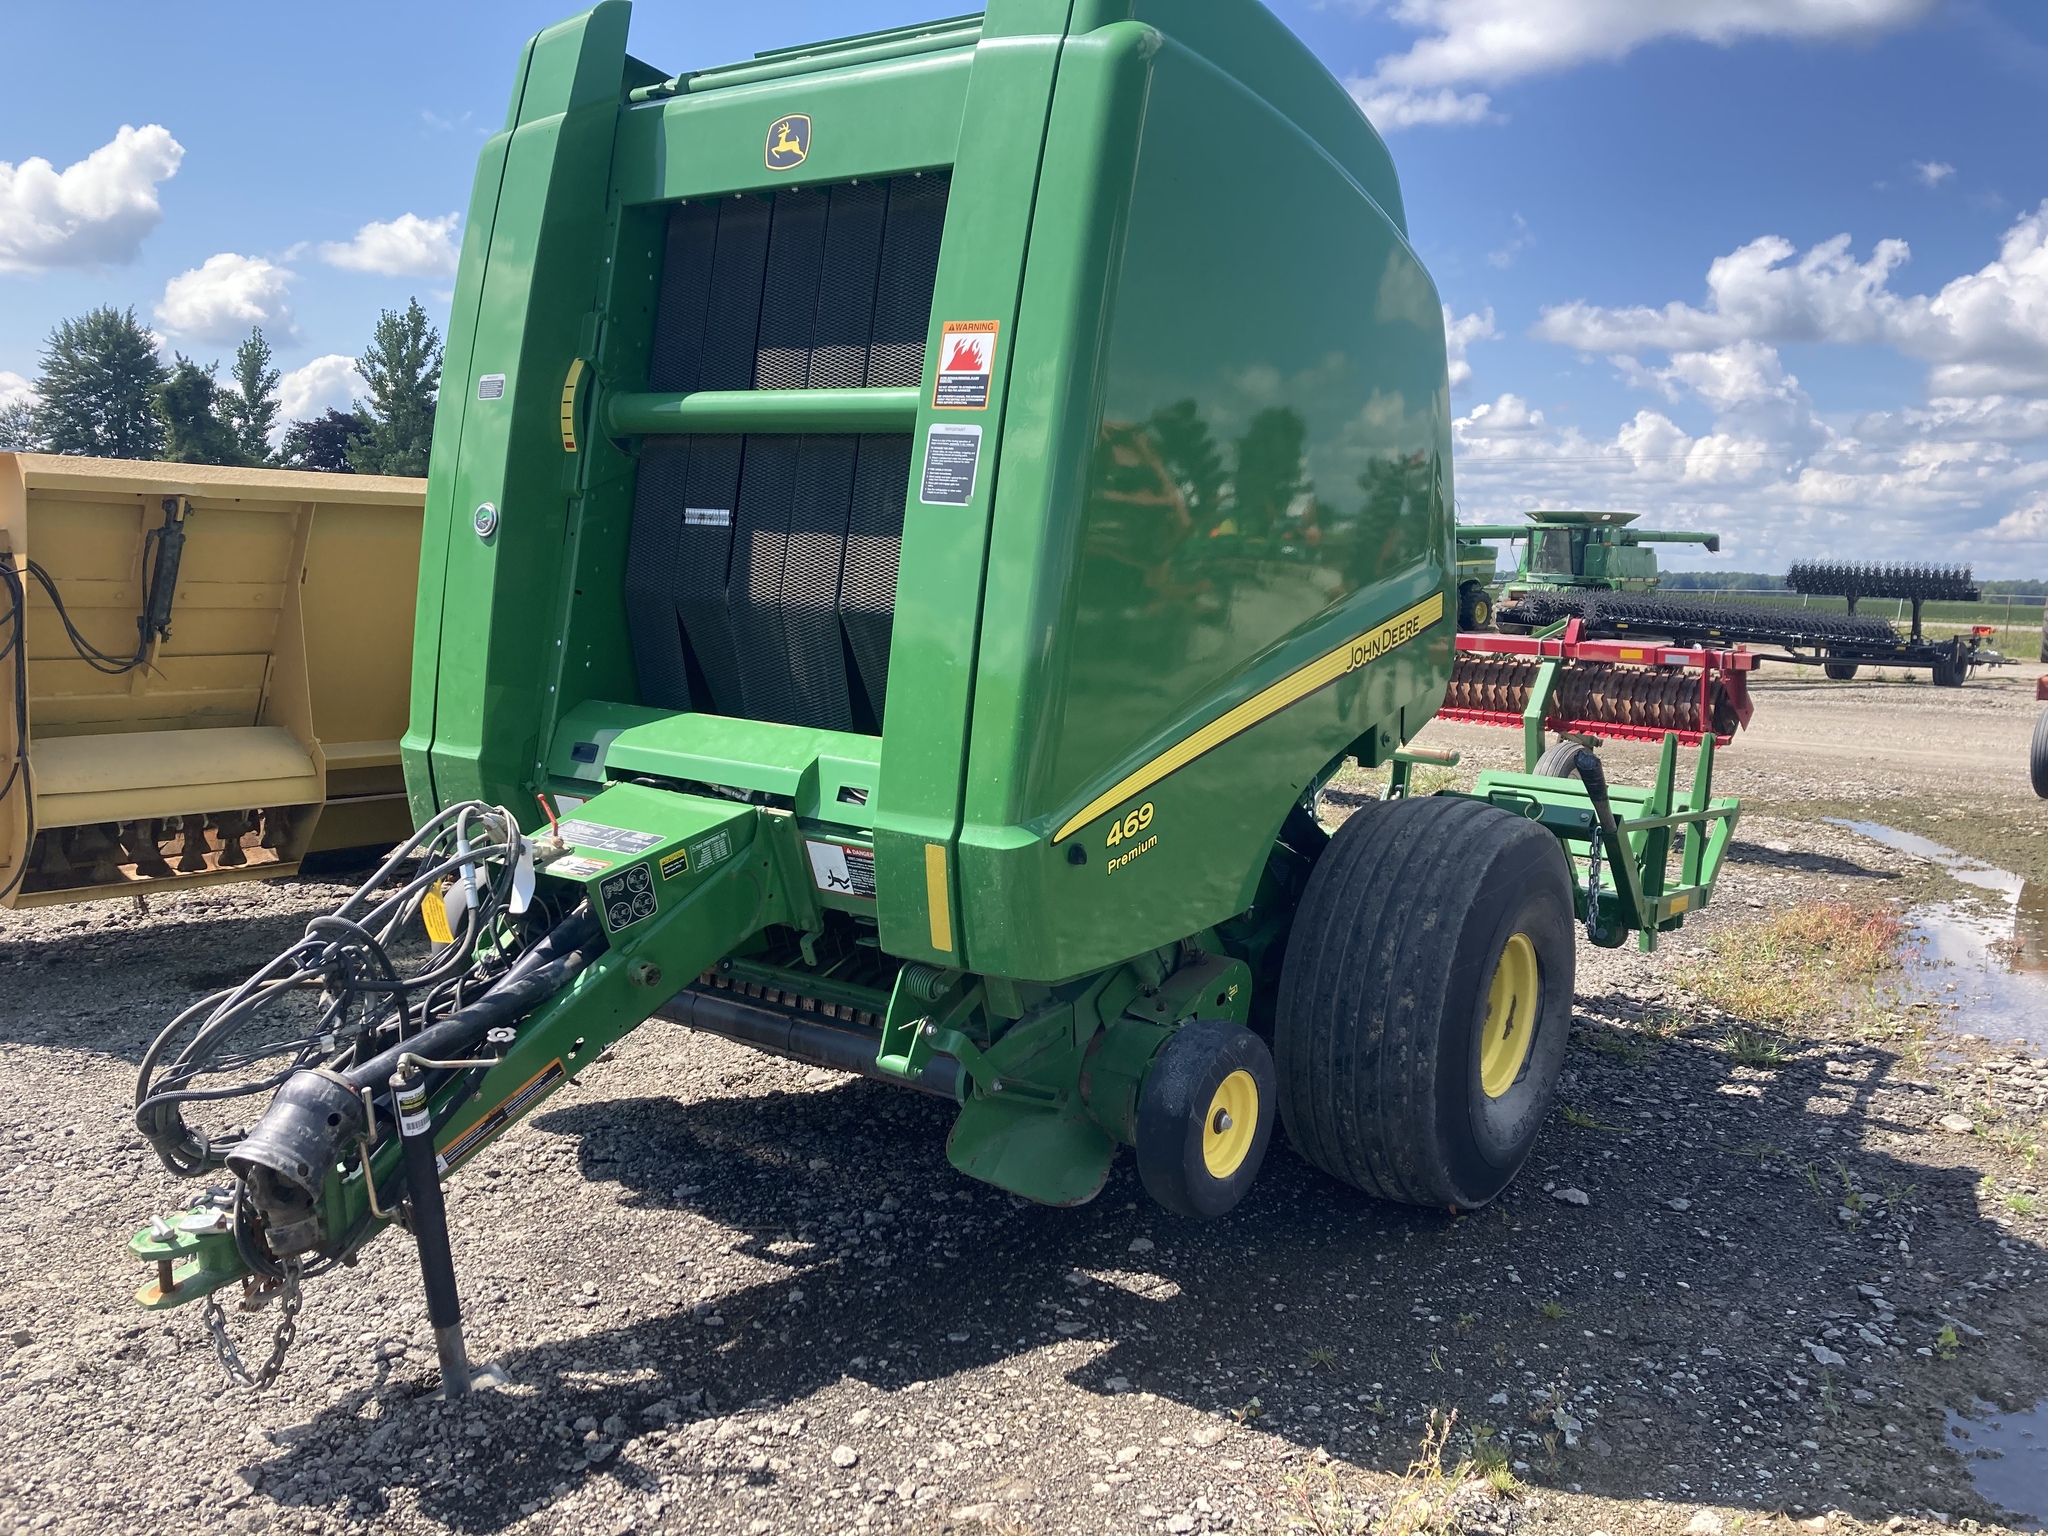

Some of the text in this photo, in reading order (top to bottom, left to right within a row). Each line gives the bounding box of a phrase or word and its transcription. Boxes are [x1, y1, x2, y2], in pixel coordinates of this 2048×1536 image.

[955, 322, 994, 331] WARNING
[1106, 801, 1155, 849] 469
[852, 849, 874, 858] DANGER
[1107, 834, 1158, 876] Premium
